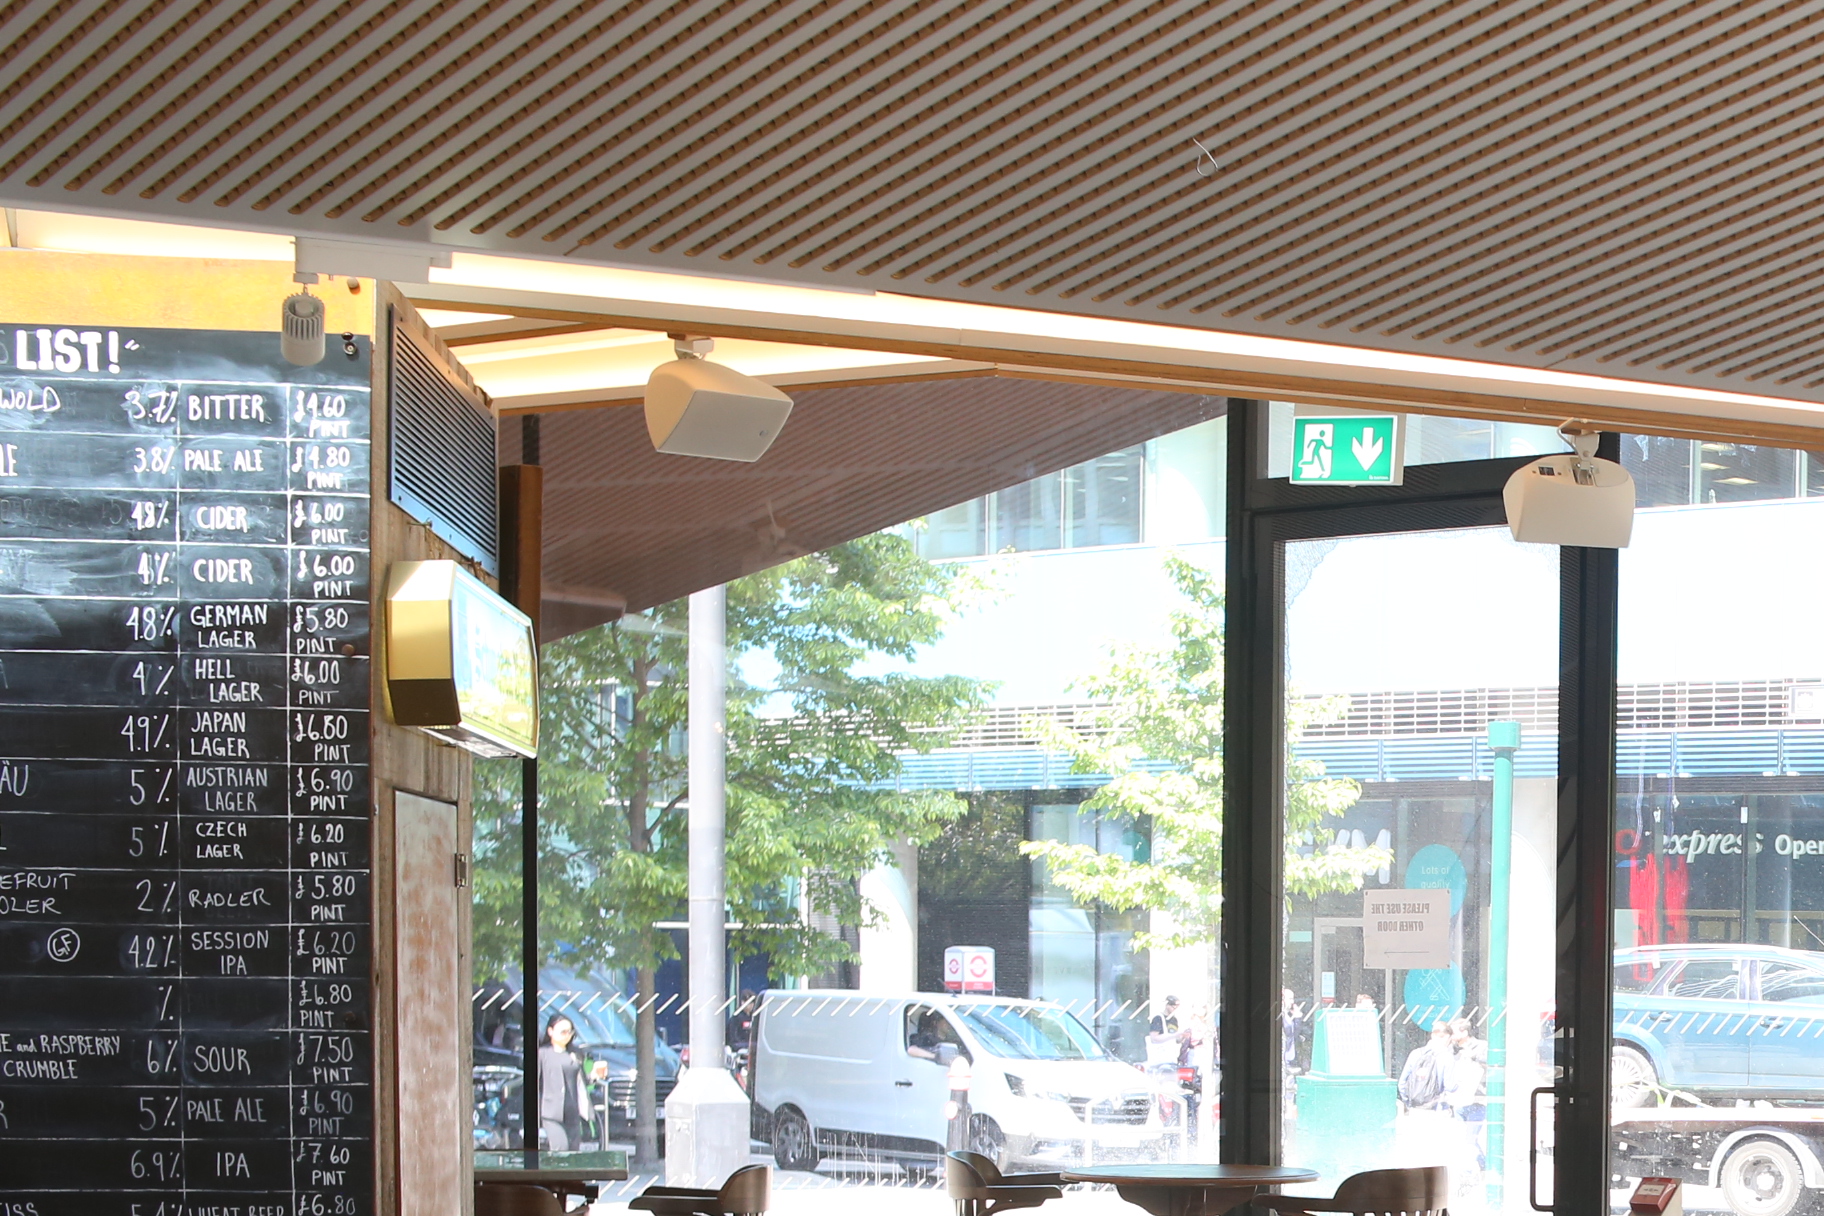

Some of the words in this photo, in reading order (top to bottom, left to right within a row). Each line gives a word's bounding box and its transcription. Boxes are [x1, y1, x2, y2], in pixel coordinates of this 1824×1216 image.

[15, 328, 121, 374] LIST!
[125, 390, 178, 423] 3.7%
[188, 394, 265, 423] BITTER
[308, 419, 351, 438] PINT
[133, 446, 176, 475] 3.8%
[184, 449, 223, 472] PALE
[233, 449, 264, 472] ALE
[307, 471, 344, 490] PINT
[196, 505, 248, 534] CIDER
[311, 528, 349, 545] PINT
[193, 558, 254, 586] CIDER
[313, 580, 354, 598] PINT
[190, 604, 268, 628] GERMAN
[197, 630, 257, 649] LAGER
[296, 637, 337, 654] PINT
[195, 658, 236, 680] HELL
[209, 681, 263, 704] LAGER
[298, 689, 340, 705] PINT
[190, 711, 246, 733] JAPAN
[190, 737, 250, 759] LAGER
[314, 742, 351, 764] PINT
[186, 766, 268, 788] AUSTRIAN
[204, 791, 258, 813] LAGER
[310, 794, 349, 812] PINT
[195, 820, 247, 838] CZECH
[196, 843, 244, 860] LAGER
[310, 851, 349, 868] PINT
[1421, 866, 1439, 875] Lots
[1441, 866, 1449, 875] of
[188, 887, 271, 909] RADLER
[311, 904, 346, 922] PINT
[190, 929, 269, 951] SESSION
[220, 954, 248, 976] IPA
[312, 956, 348, 975] PINT
[299, 1009, 335, 1029] PINT
[17, 1038, 38, 1053] and
[39, 1034, 121, 1056] RASPBERRY
[3, 1059, 79, 1080] CRUMBLE
[193, 1045, 251, 1076] SOUR
[312, 1066, 353, 1084] PINT
[187, 1098, 225, 1122] PALE
[235, 1097, 267, 1123] ALE
[308, 1117, 345, 1136] PINT
[217, 1152, 250, 1178] IPA
[312, 1169, 347, 1187] PINT
